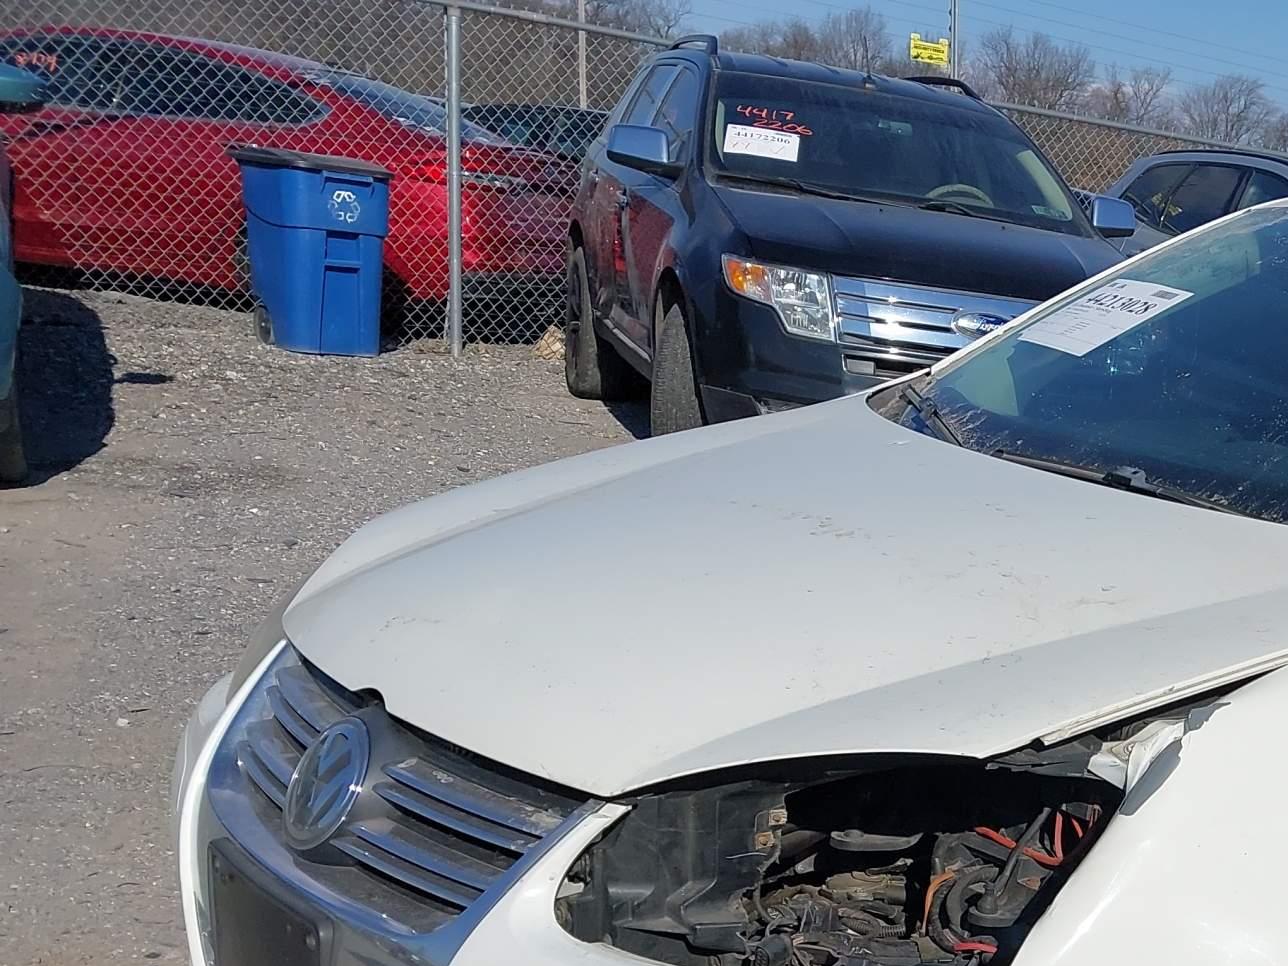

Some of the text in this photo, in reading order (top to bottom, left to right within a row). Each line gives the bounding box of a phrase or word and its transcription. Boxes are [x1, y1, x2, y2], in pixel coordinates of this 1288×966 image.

[736, 104, 795, 120] 4417
[752, 118, 813, 136] 2206
[1087, 292, 1158, 316] 44213028
